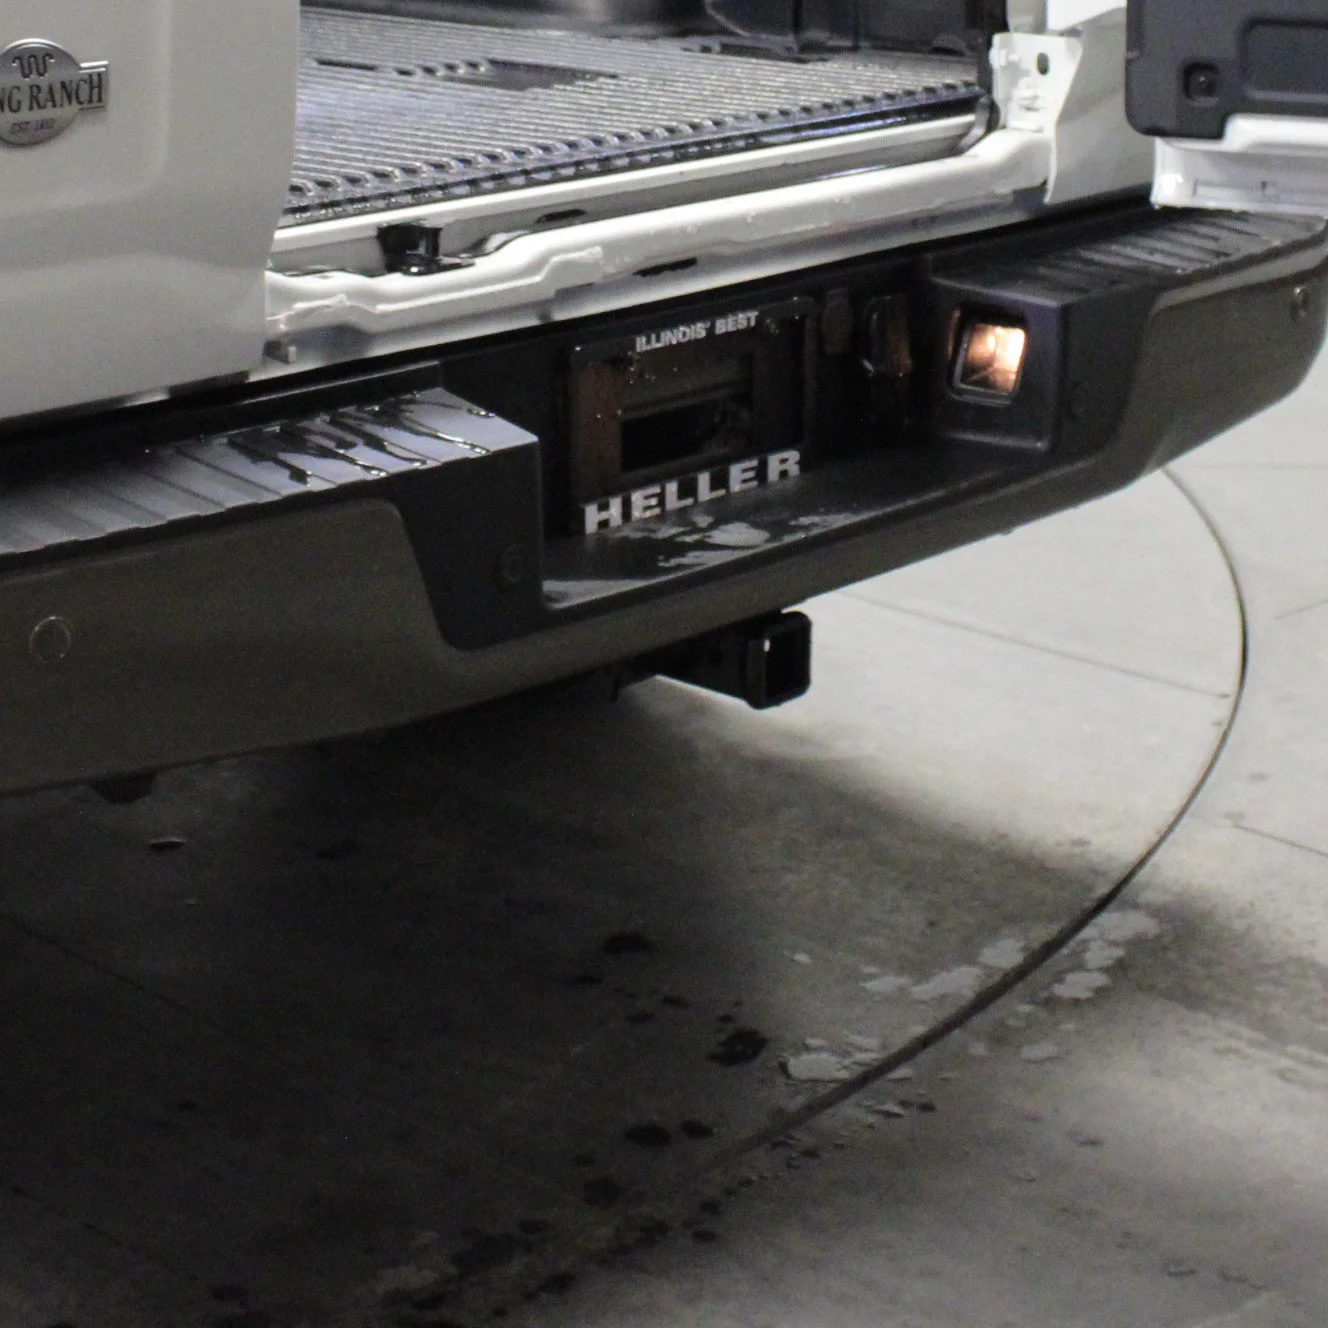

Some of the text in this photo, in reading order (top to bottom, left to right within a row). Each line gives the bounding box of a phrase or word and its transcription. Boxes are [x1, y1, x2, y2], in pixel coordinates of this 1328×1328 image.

[27, 72, 104, 112] RANCH
[714, 311, 759, 335] BEST
[584, 449, 801, 535] HELLER
